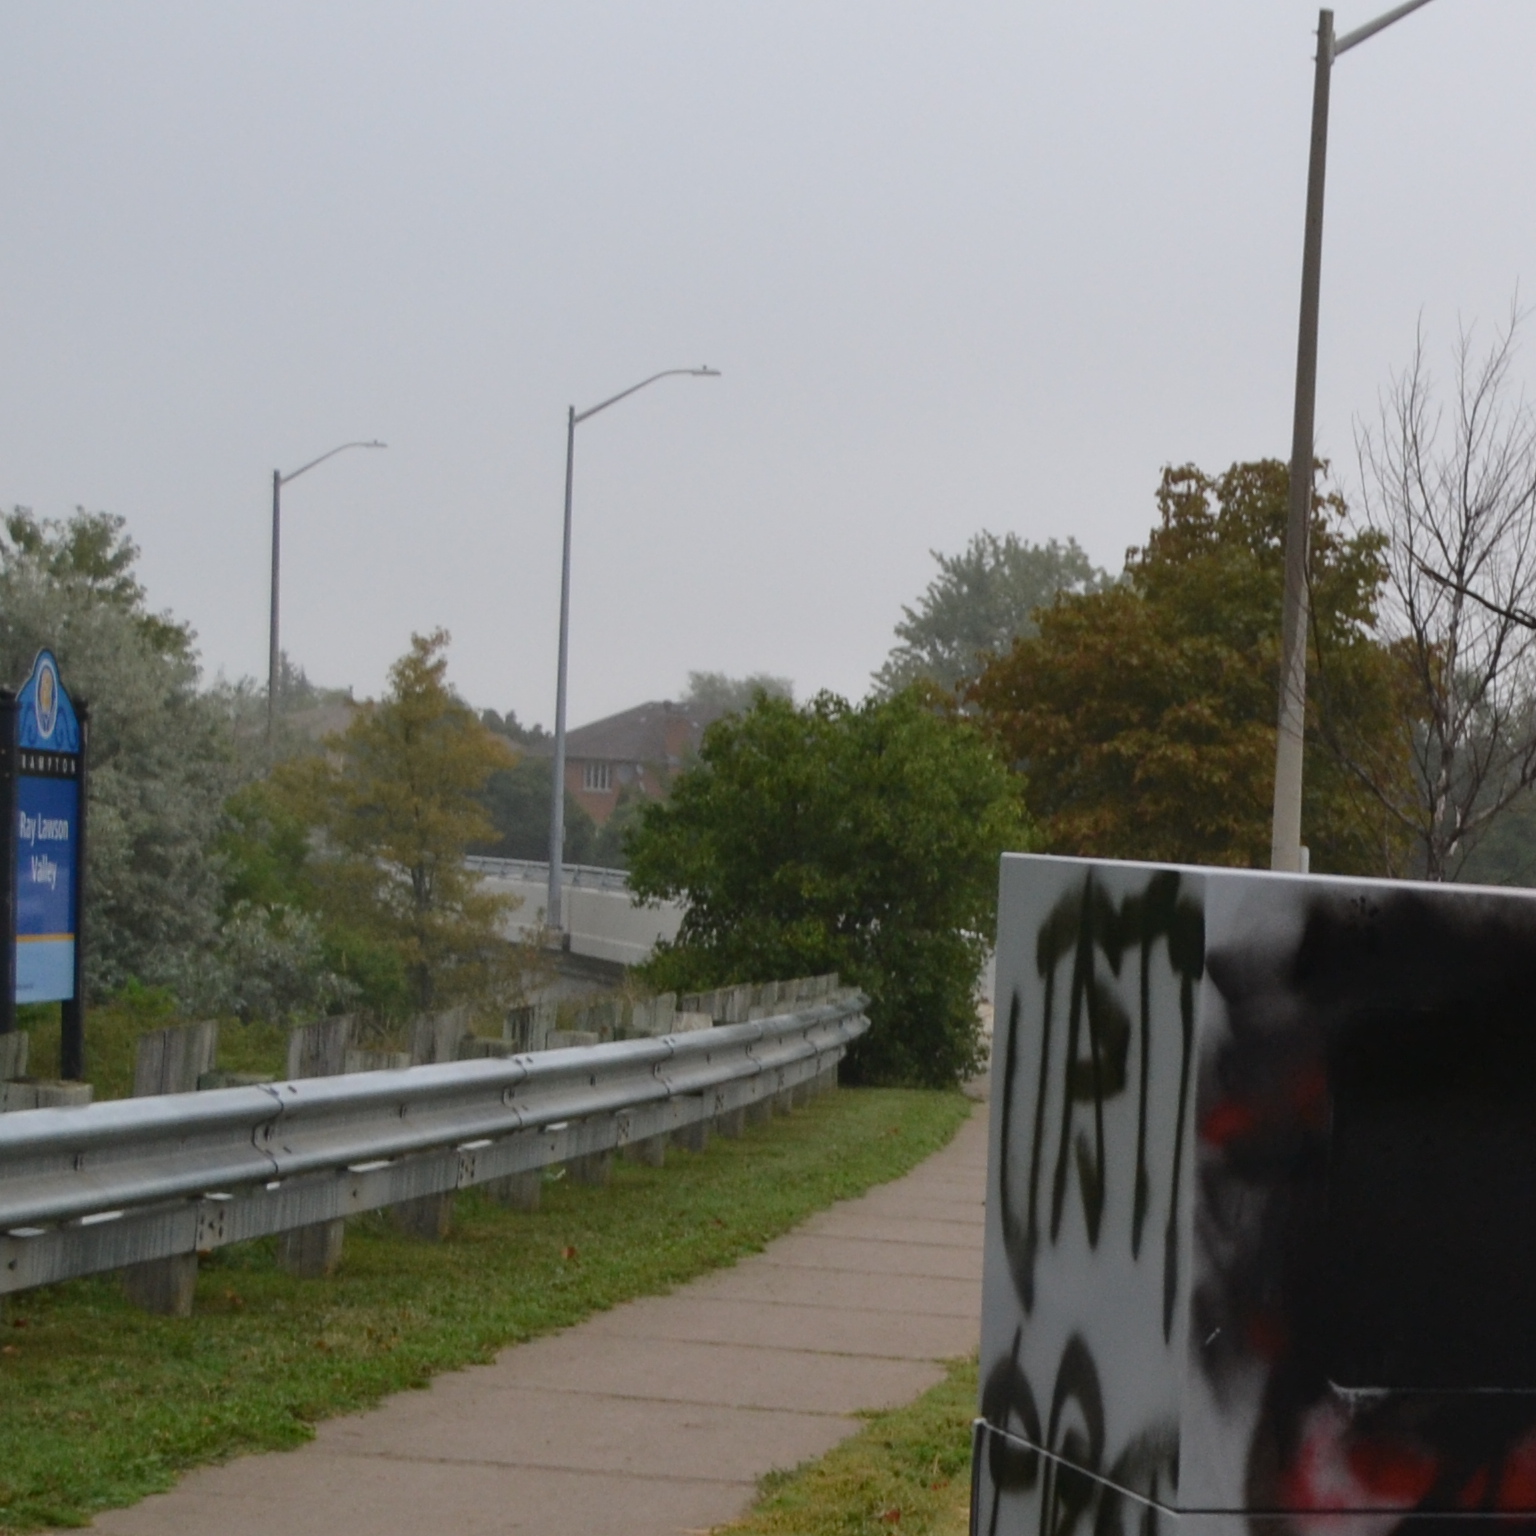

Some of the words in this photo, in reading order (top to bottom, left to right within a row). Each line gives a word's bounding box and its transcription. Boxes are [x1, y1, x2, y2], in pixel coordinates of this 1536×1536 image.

[22, 754, 76, 773] RAMPTON
[20, 811, 37, 846] Ray
[38, 812, 69, 840] Lawson
[31, 854, 57, 890] Valley
